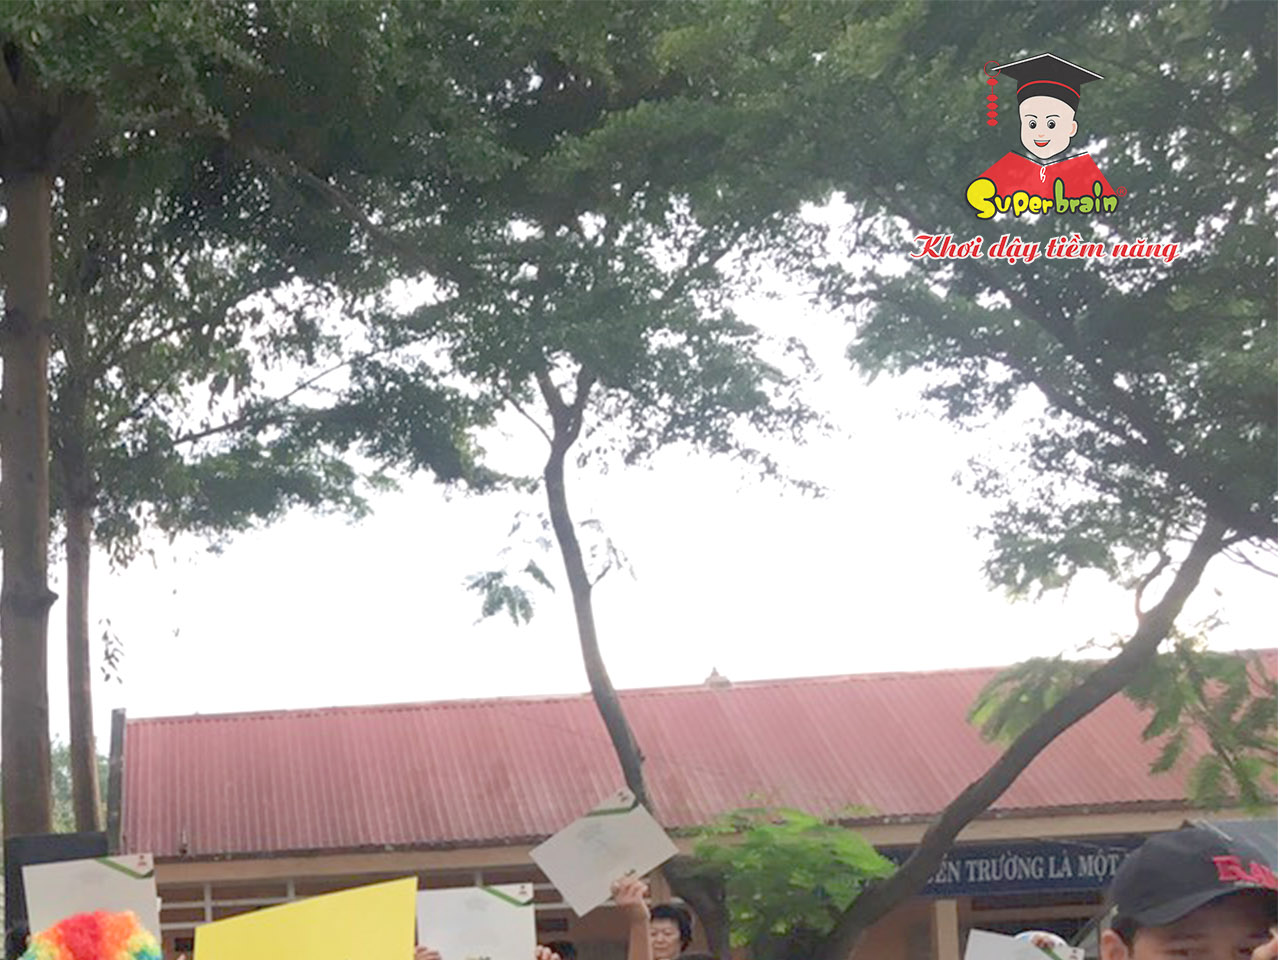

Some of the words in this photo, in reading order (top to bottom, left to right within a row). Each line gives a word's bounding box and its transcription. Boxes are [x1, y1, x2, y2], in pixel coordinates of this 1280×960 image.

[928, 853, 962, 884] ẾN
[965, 851, 1044, 883] TRƯỜNG
[1048, 850, 1073, 878] LÀ
[1077, 848, 1119, 882] MỘT
